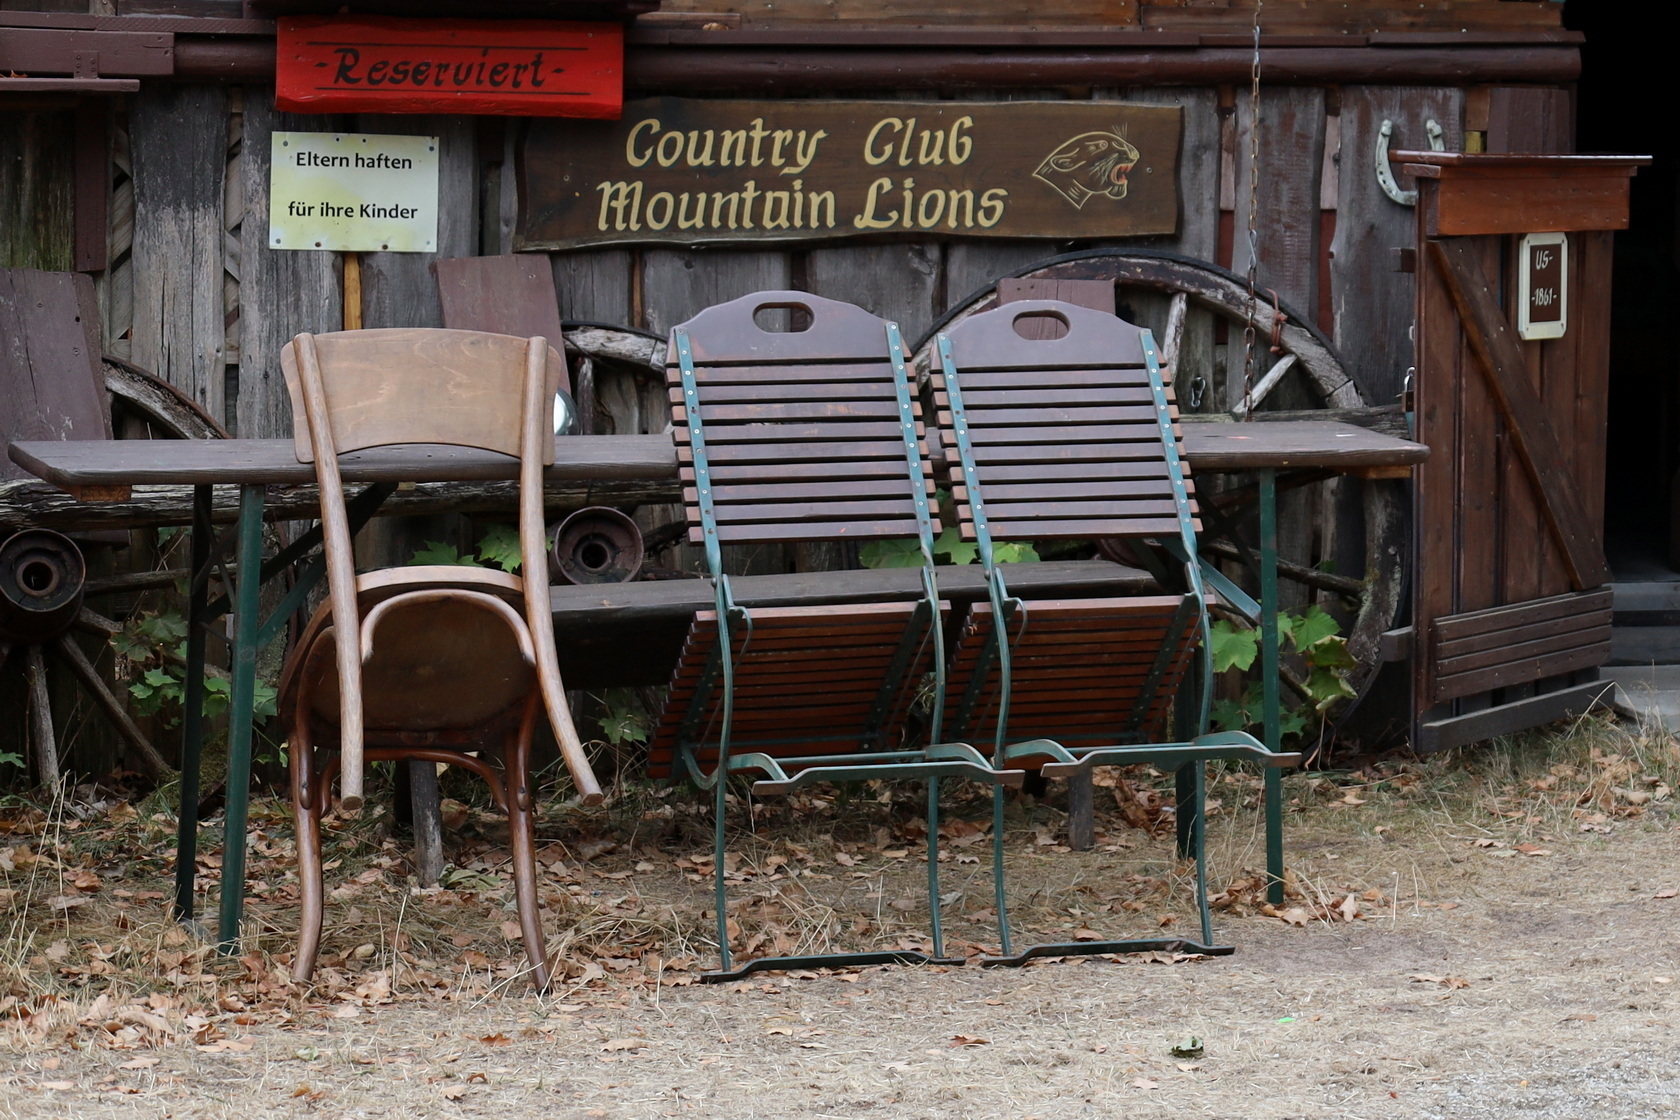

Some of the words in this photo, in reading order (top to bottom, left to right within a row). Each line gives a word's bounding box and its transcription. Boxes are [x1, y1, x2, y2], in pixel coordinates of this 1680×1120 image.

[296, 152, 350, 168] Eltern
[355, 153, 412, 169] haften
[626, 117, 829, 175] Country
[864, 116, 974, 166] Club
[288, 201, 315, 217] für
[320, 202, 354, 218] ihre
[360, 203, 418, 219] Kinder
[597, 178, 836, 231] Mountain
[853, 176, 1008, 230] Lions
